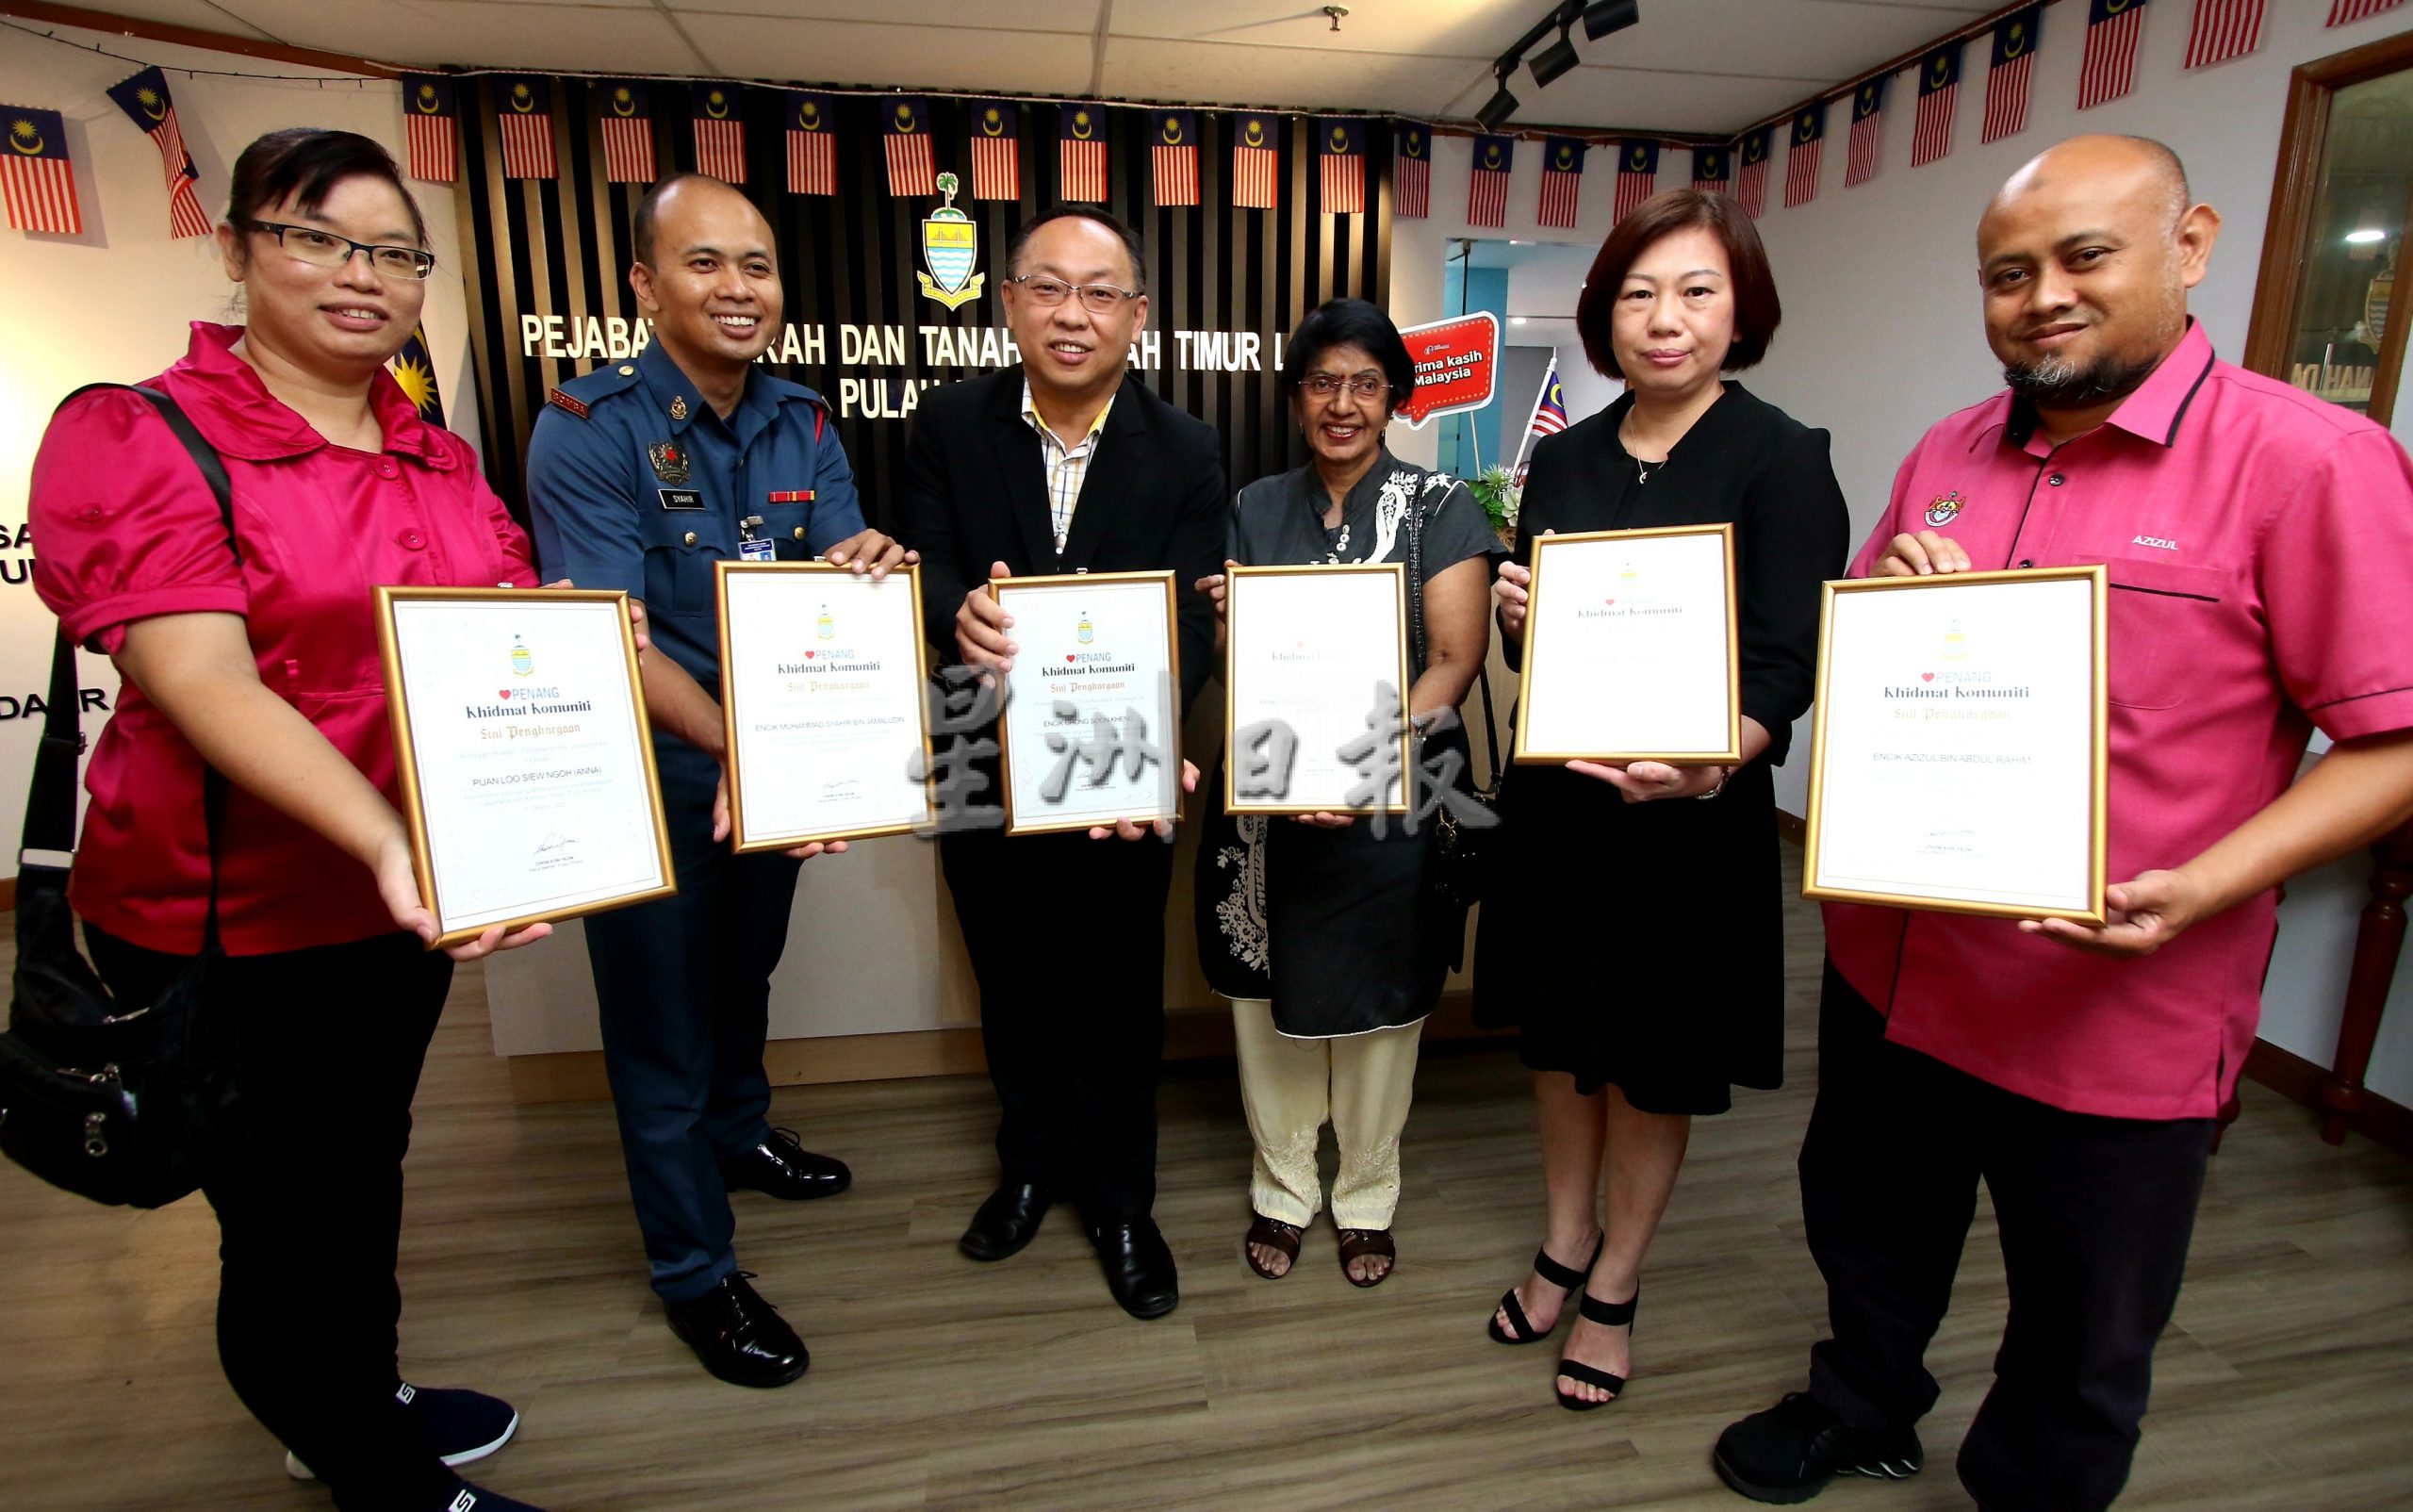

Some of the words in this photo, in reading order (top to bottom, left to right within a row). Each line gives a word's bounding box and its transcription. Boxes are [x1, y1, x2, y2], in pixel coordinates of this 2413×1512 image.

[521, 314, 654, 359] PEJABA
[841, 324, 905, 366] DAN
[918, 325, 1023, 368] TANAH
[1174, 330, 1261, 371] TIMUR
[1414, 359, 1444, 374] rima
[1446, 350, 1483, 368] kasih
[1414, 367, 1471, 387] Malaysia
[840, 378, 941, 419] PULA
[672, 495, 695, 503] SYAHIR
[2132, 534, 2178, 551] AZIZUL
[815, 649, 855, 660] PENANG
[1075, 652, 1111, 663] PENANG
[778, 663, 827, 675] Khidmat
[830, 661, 880, 673] Komuniti
[1042, 665, 1086, 677] Khidmat
[1089, 663, 1135, 675] Komuniti
[1935, 671, 1993, 683] PENANG
[512, 686, 560, 700] PENANG
[1071, 681, 1125, 694] Penghargaan
[1883, 686, 1949, 698] Khidmat
[1955, 685, 2029, 698] Komuniti
[466, 705, 526, 719] Khidmat
[532, 701, 591, 715] Komuniti
[506, 723, 582, 740] Penghargaan
[1903, 753, 1938, 763] AZIZUL
[472, 776, 500, 787] PUAN
[501, 774, 520, 784] LOO
[522, 772, 545, 782] SIEW
[546, 769, 572, 781] NGOH
[573, 765, 602, 778] (ANNA)
